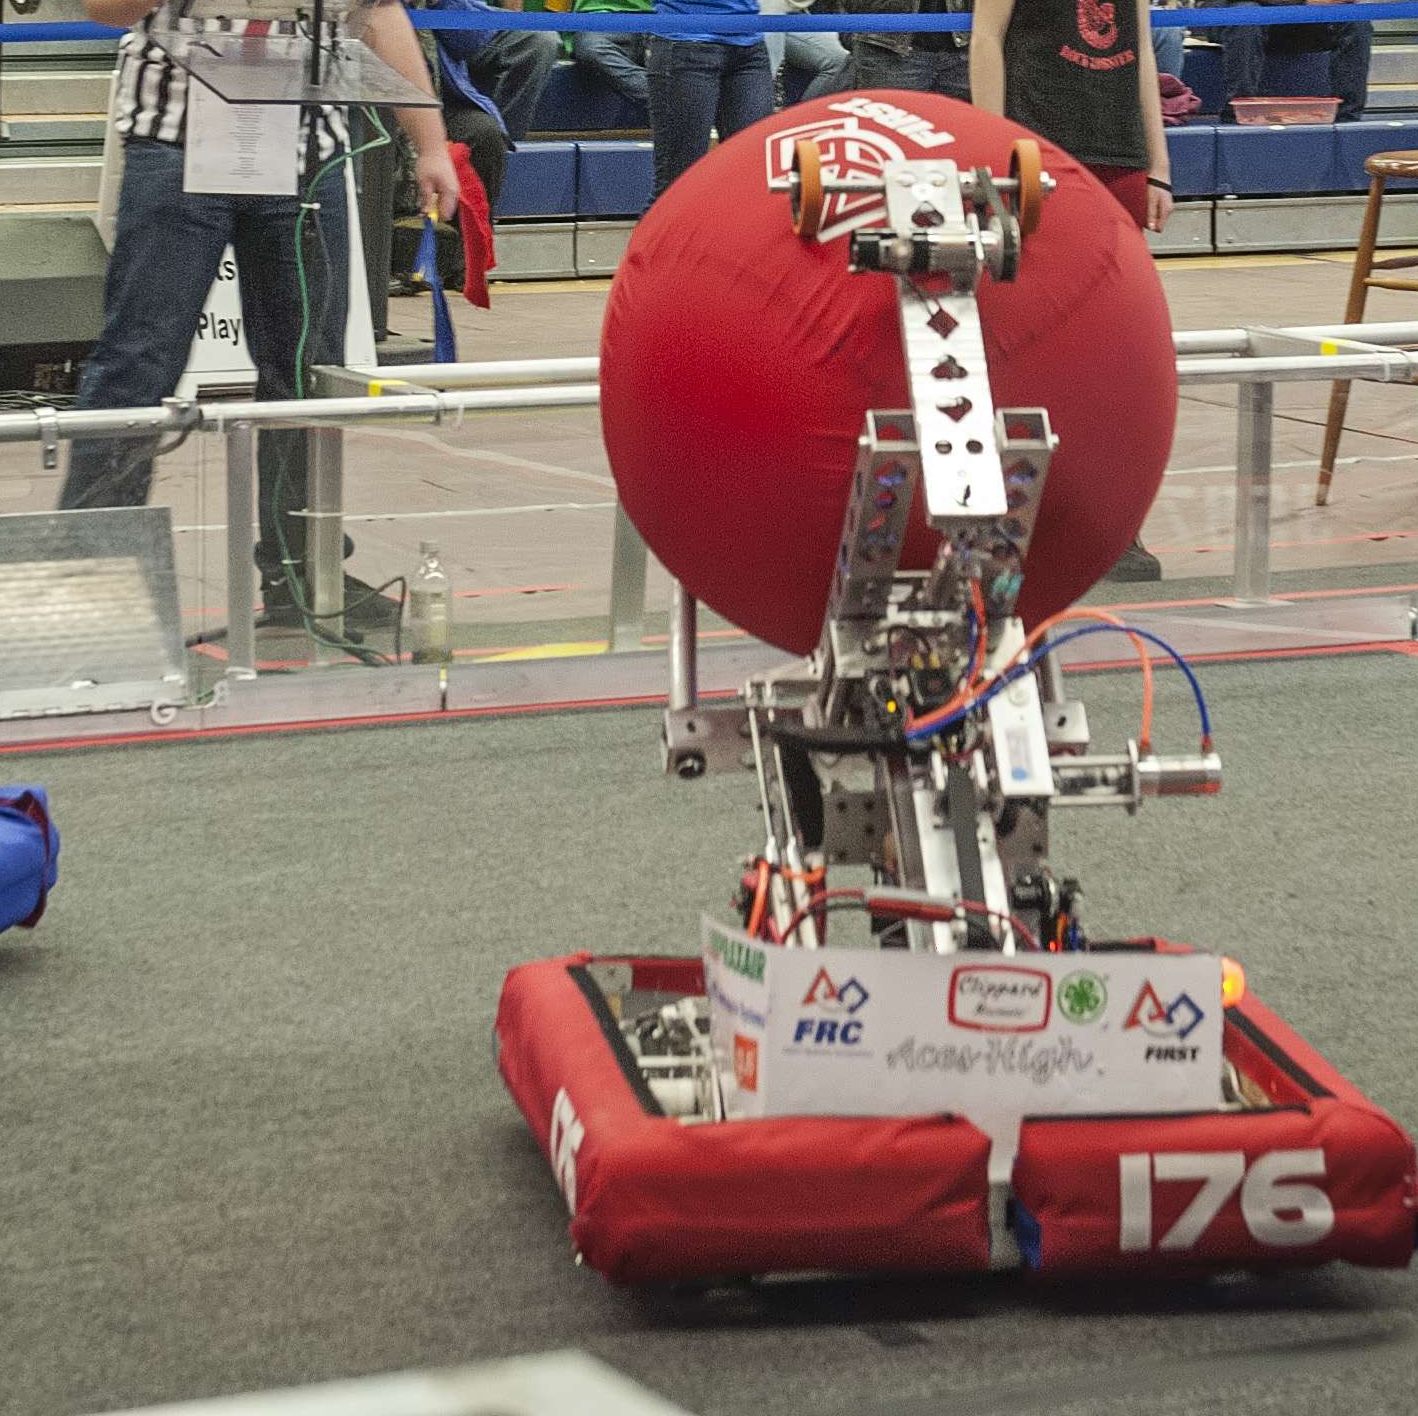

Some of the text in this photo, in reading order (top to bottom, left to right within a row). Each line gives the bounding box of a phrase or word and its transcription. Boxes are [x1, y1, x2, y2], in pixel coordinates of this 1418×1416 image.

[828, 97, 956, 148] FIRST
[197, 312, 241, 346] Play
[793, 1019, 864, 1046] FRC
[1144, 1045, 1199, 1062] FIRST
[1117, 1148, 1336, 1253] 176
